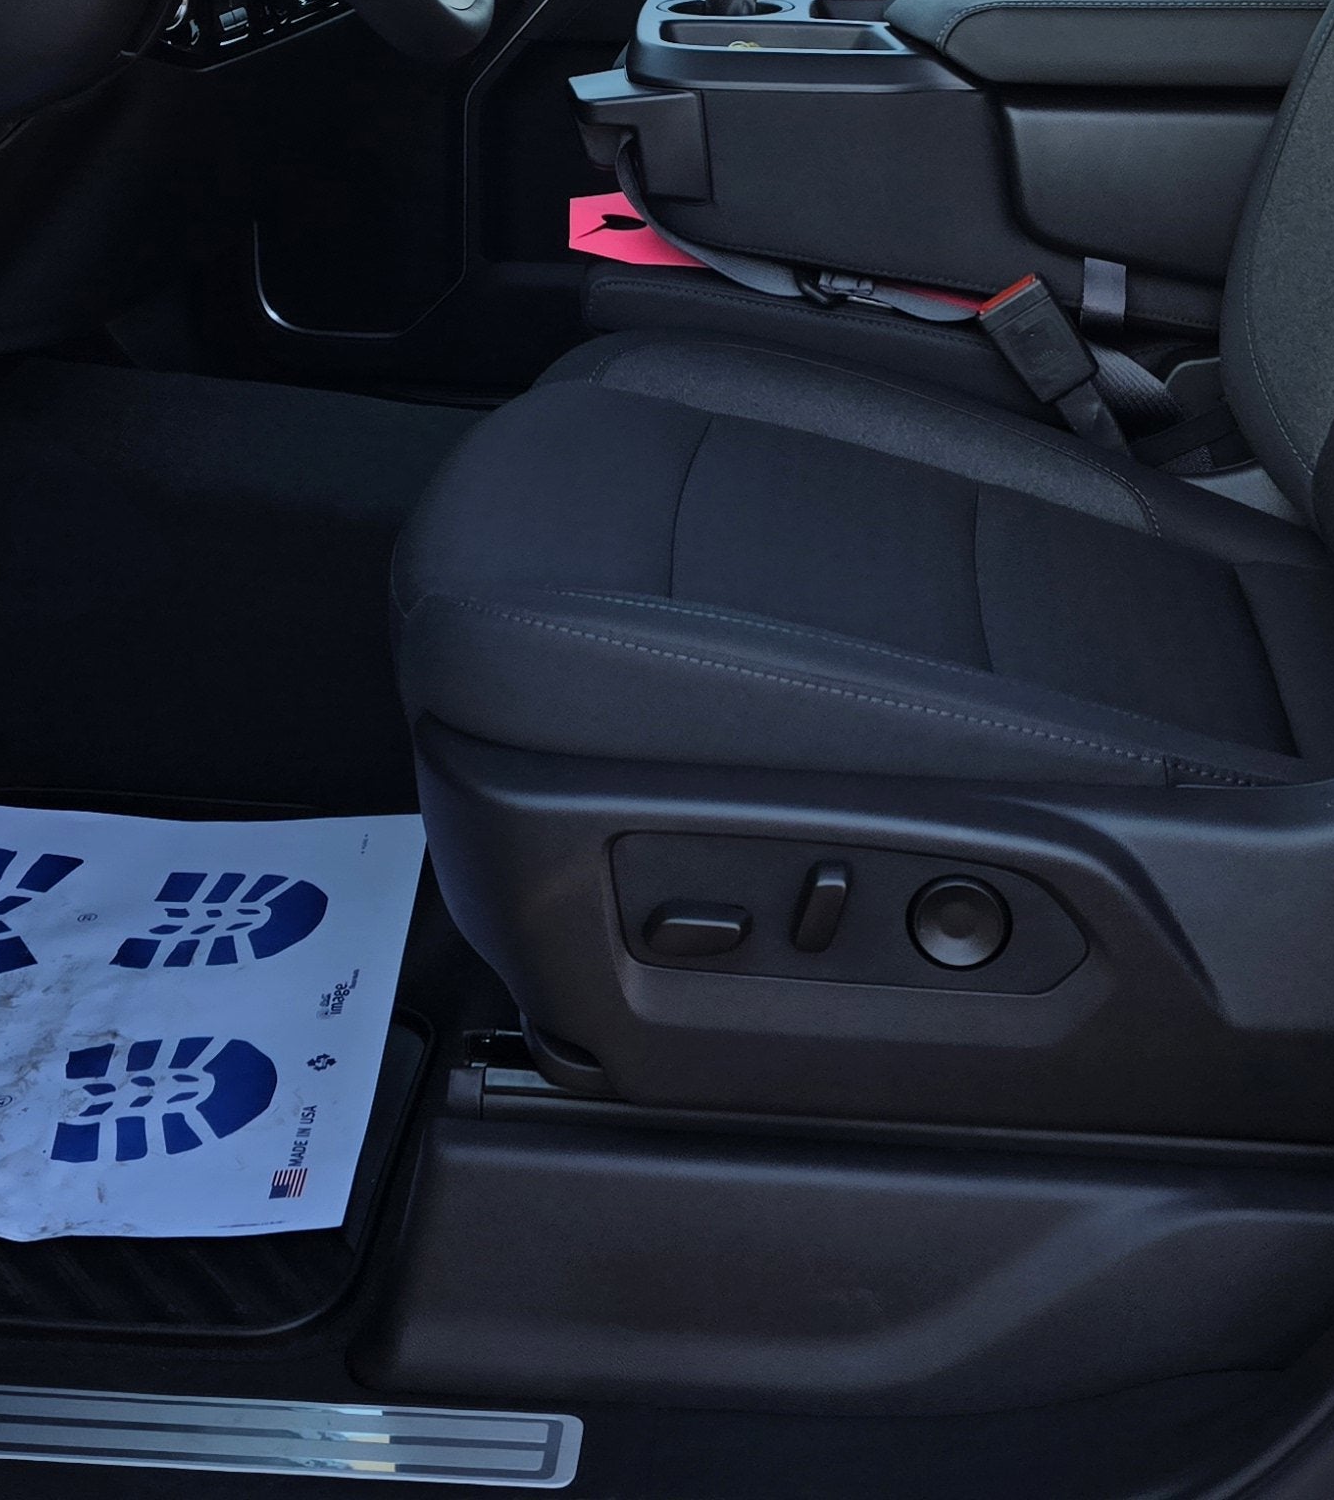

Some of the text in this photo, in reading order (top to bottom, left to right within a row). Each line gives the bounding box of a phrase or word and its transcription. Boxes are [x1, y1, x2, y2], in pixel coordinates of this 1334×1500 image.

[288, 1104, 318, 1167] MADE IN USA
